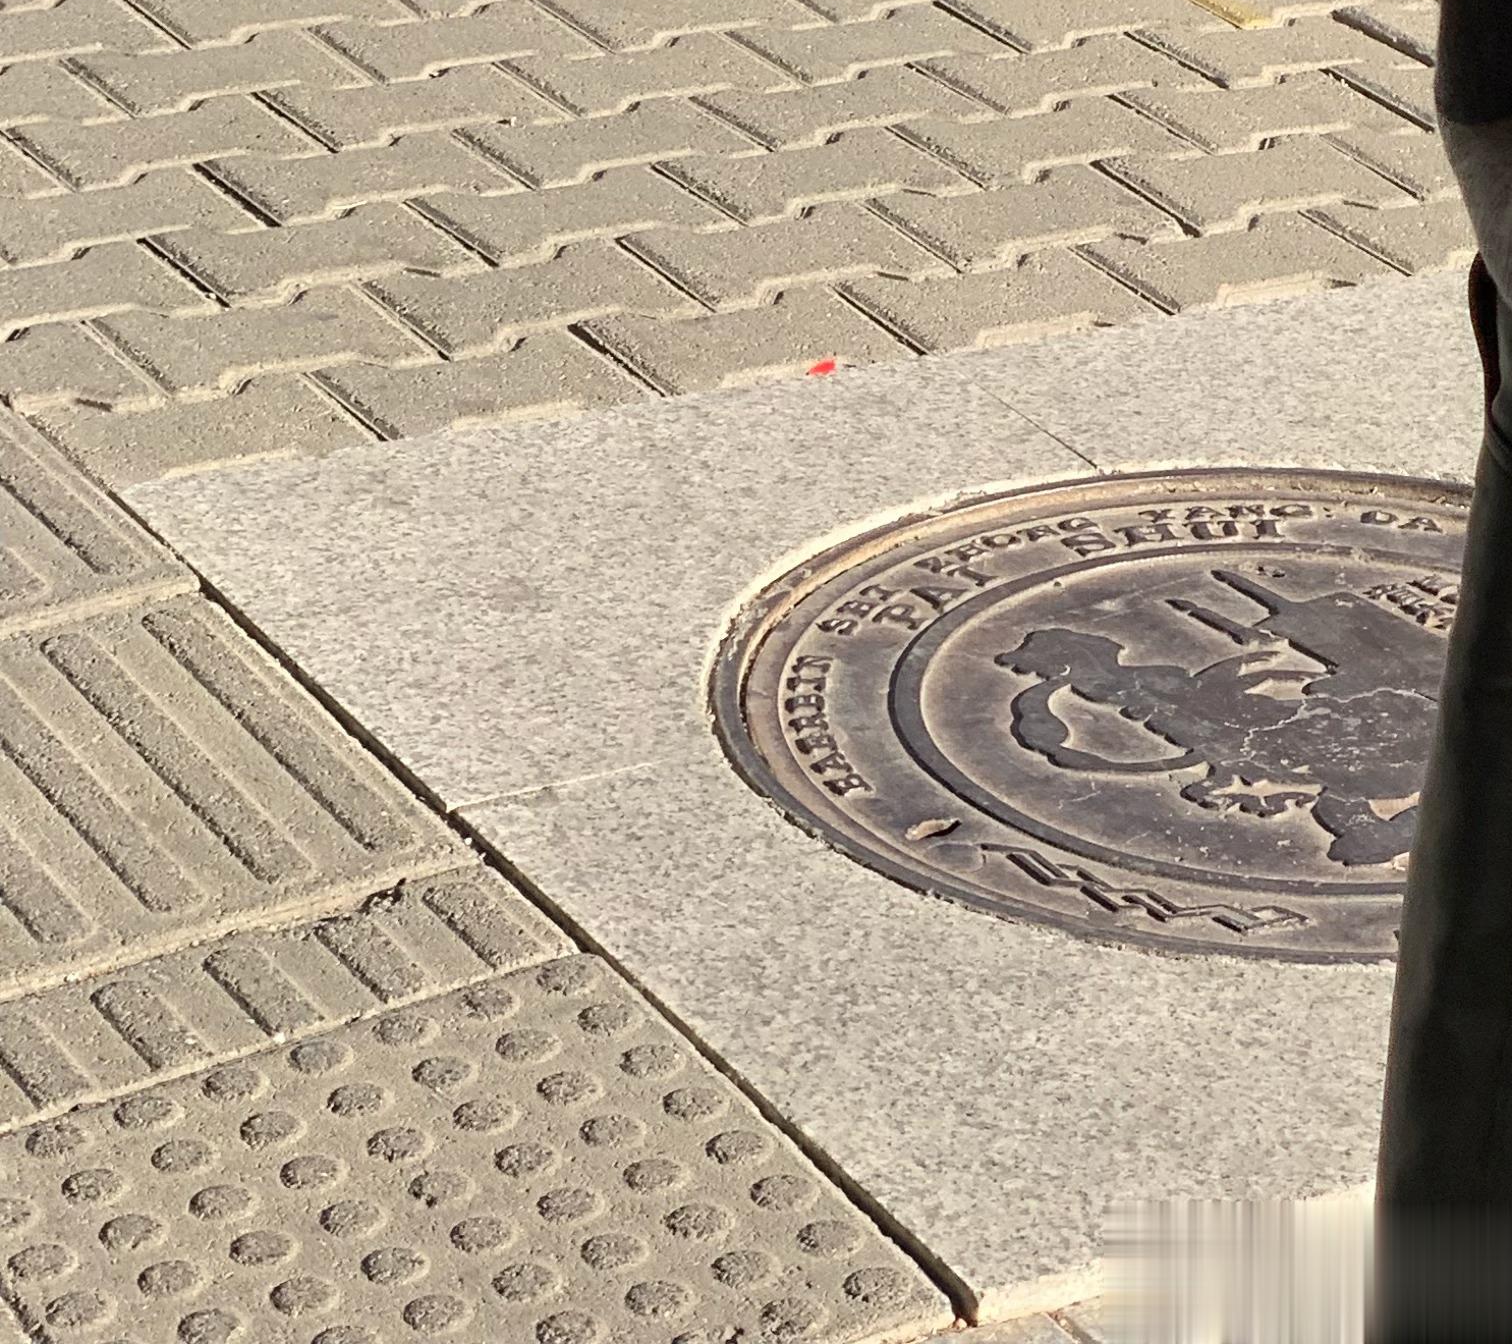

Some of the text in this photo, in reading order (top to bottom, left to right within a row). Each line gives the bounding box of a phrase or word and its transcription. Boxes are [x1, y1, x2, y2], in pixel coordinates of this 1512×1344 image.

[1138, 503, 1314, 523] YANG
[1360, 509, 1444, 533] DA
[1060, 518, 1286, 559] SHUI
